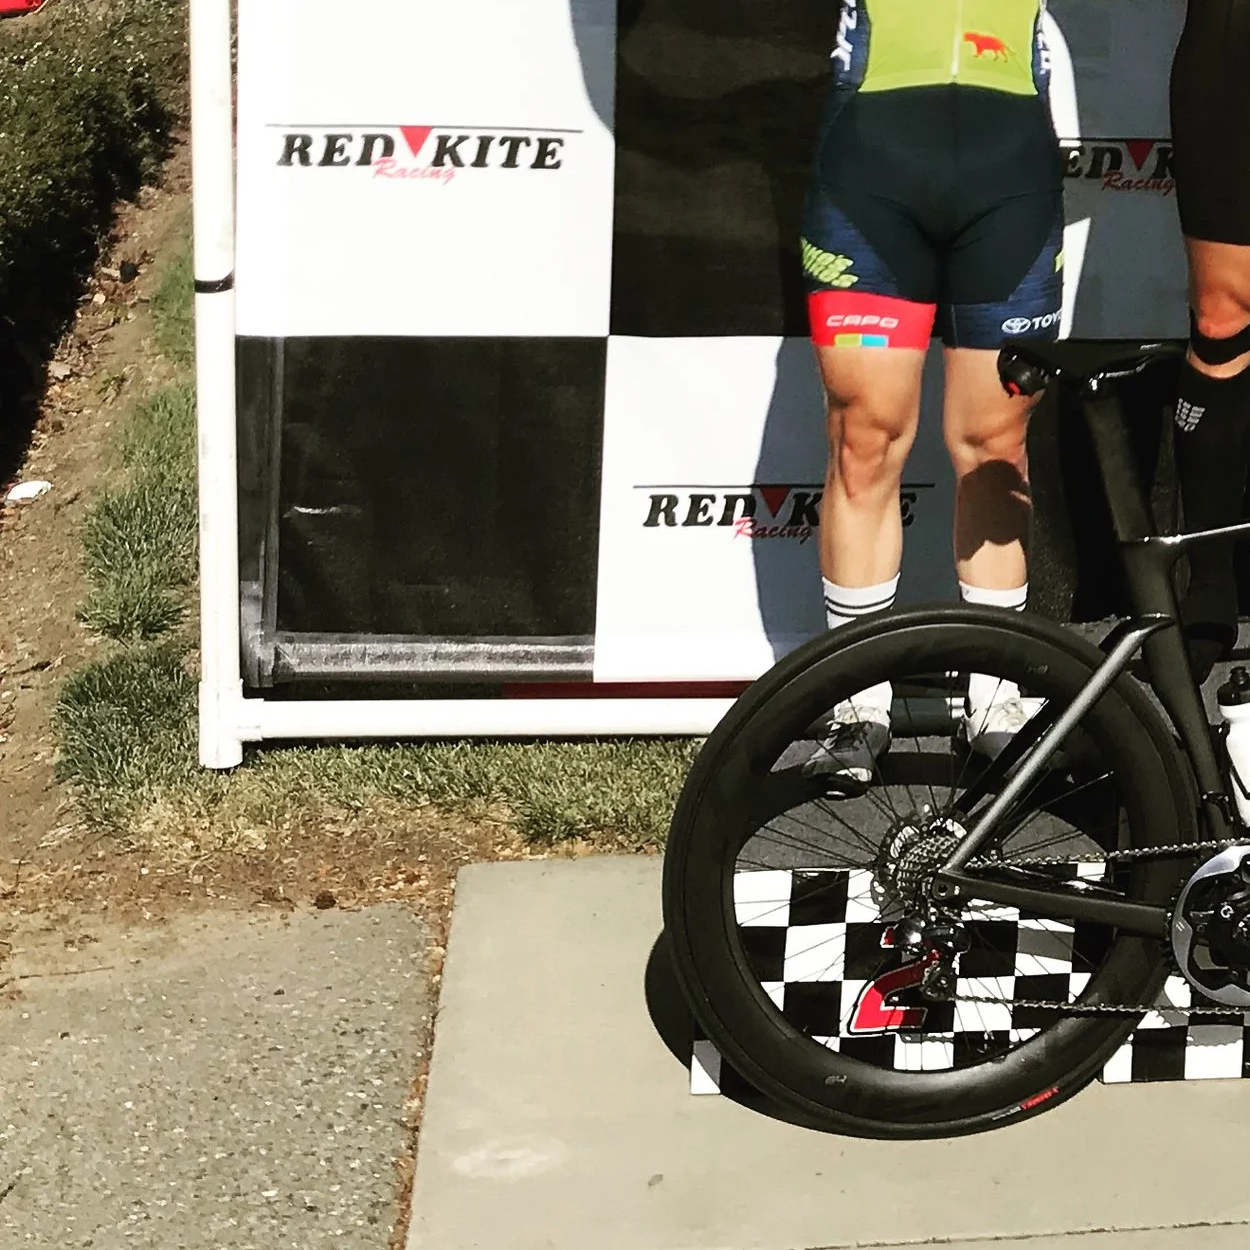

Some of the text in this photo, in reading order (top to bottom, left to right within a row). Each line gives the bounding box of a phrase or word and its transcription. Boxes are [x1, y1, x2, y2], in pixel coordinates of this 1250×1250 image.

[276, 134, 565, 170] RED KITE
[372, 156, 457, 186] Racing
[1101, 170, 1175, 196] Racing
[826, 314, 899, 328] CAPO
[643, 494, 757, 527] RED
[733, 517, 814, 545] Racing
